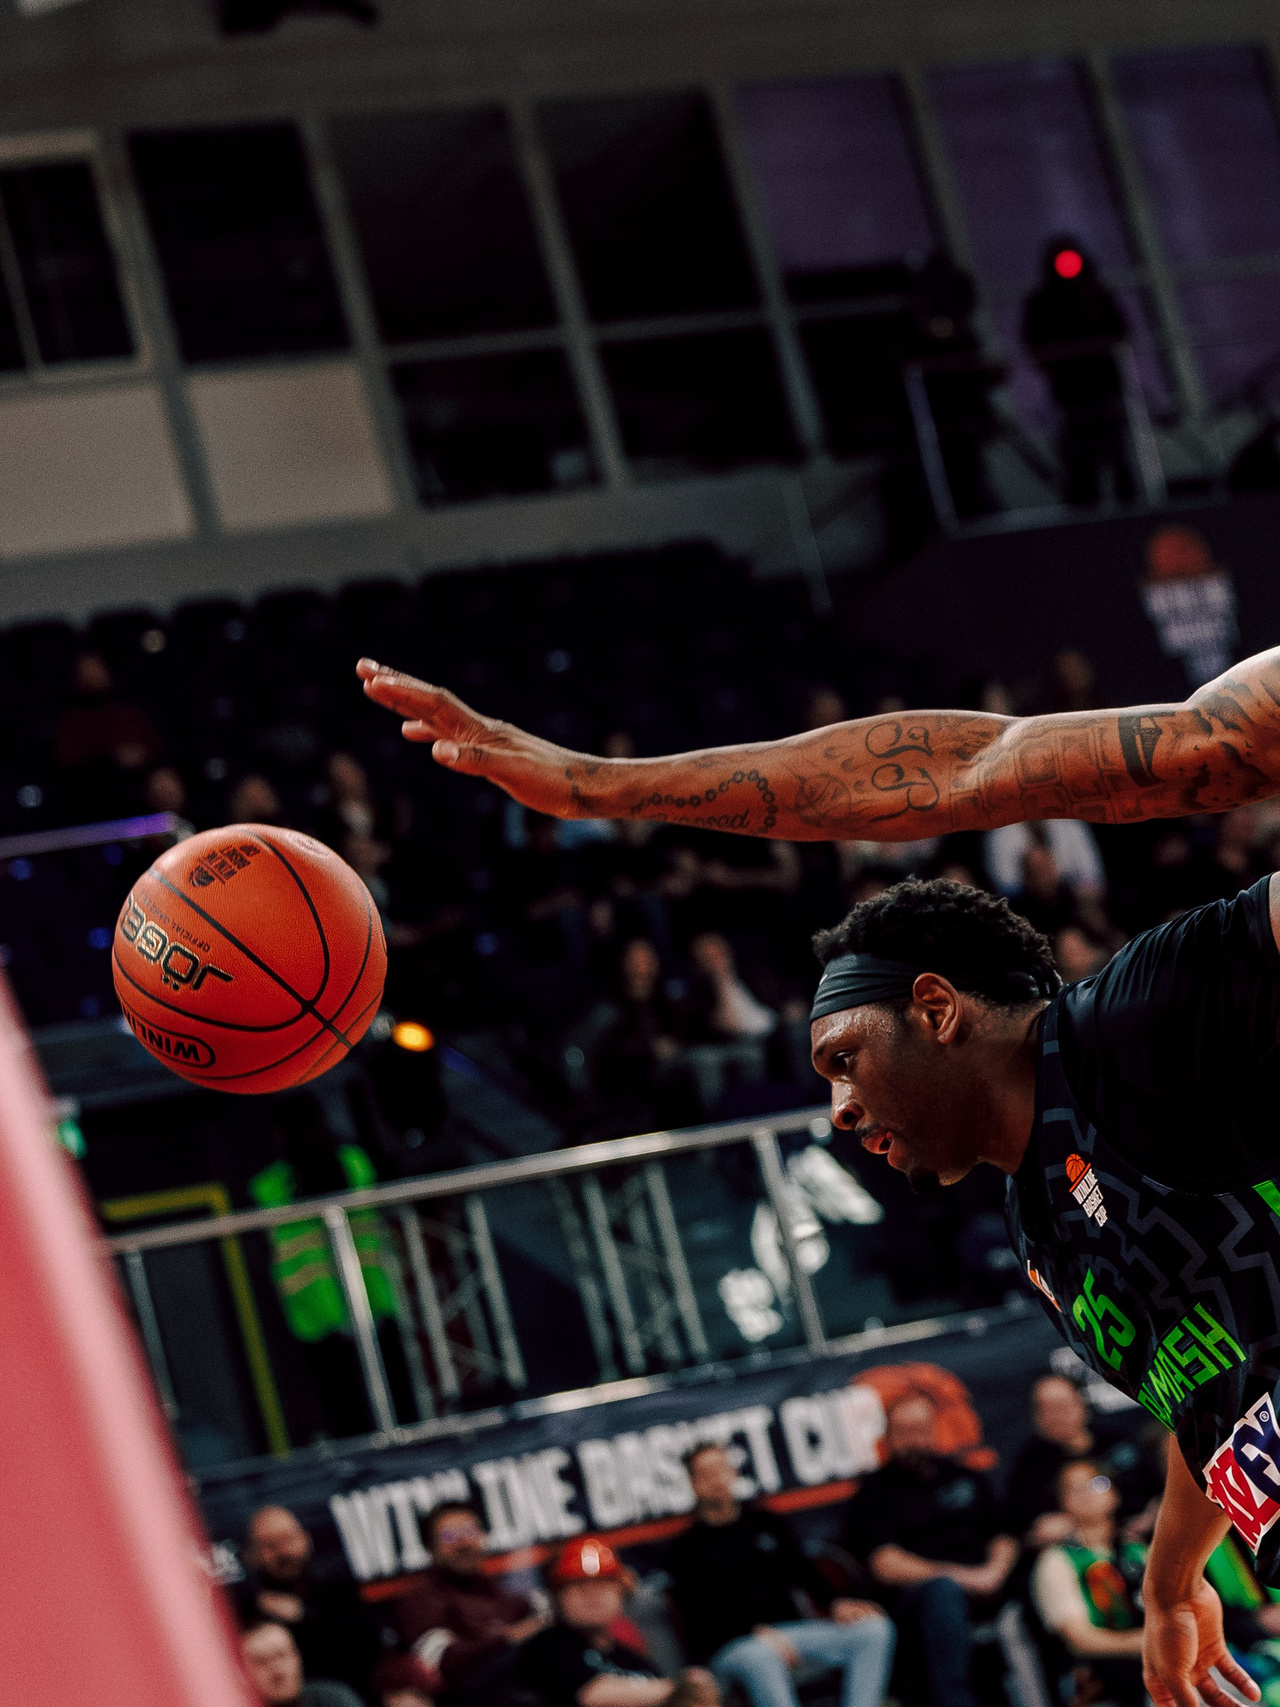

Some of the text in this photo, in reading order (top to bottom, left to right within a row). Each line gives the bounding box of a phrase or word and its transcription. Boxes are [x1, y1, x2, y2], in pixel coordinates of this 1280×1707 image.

[1072, 1168, 1098, 1205] WINLINE
[1082, 1185, 1104, 1218] BASKET
[1094, 1205, 1108, 1228] CUP
[1073, 1267, 1136, 1371] 25
